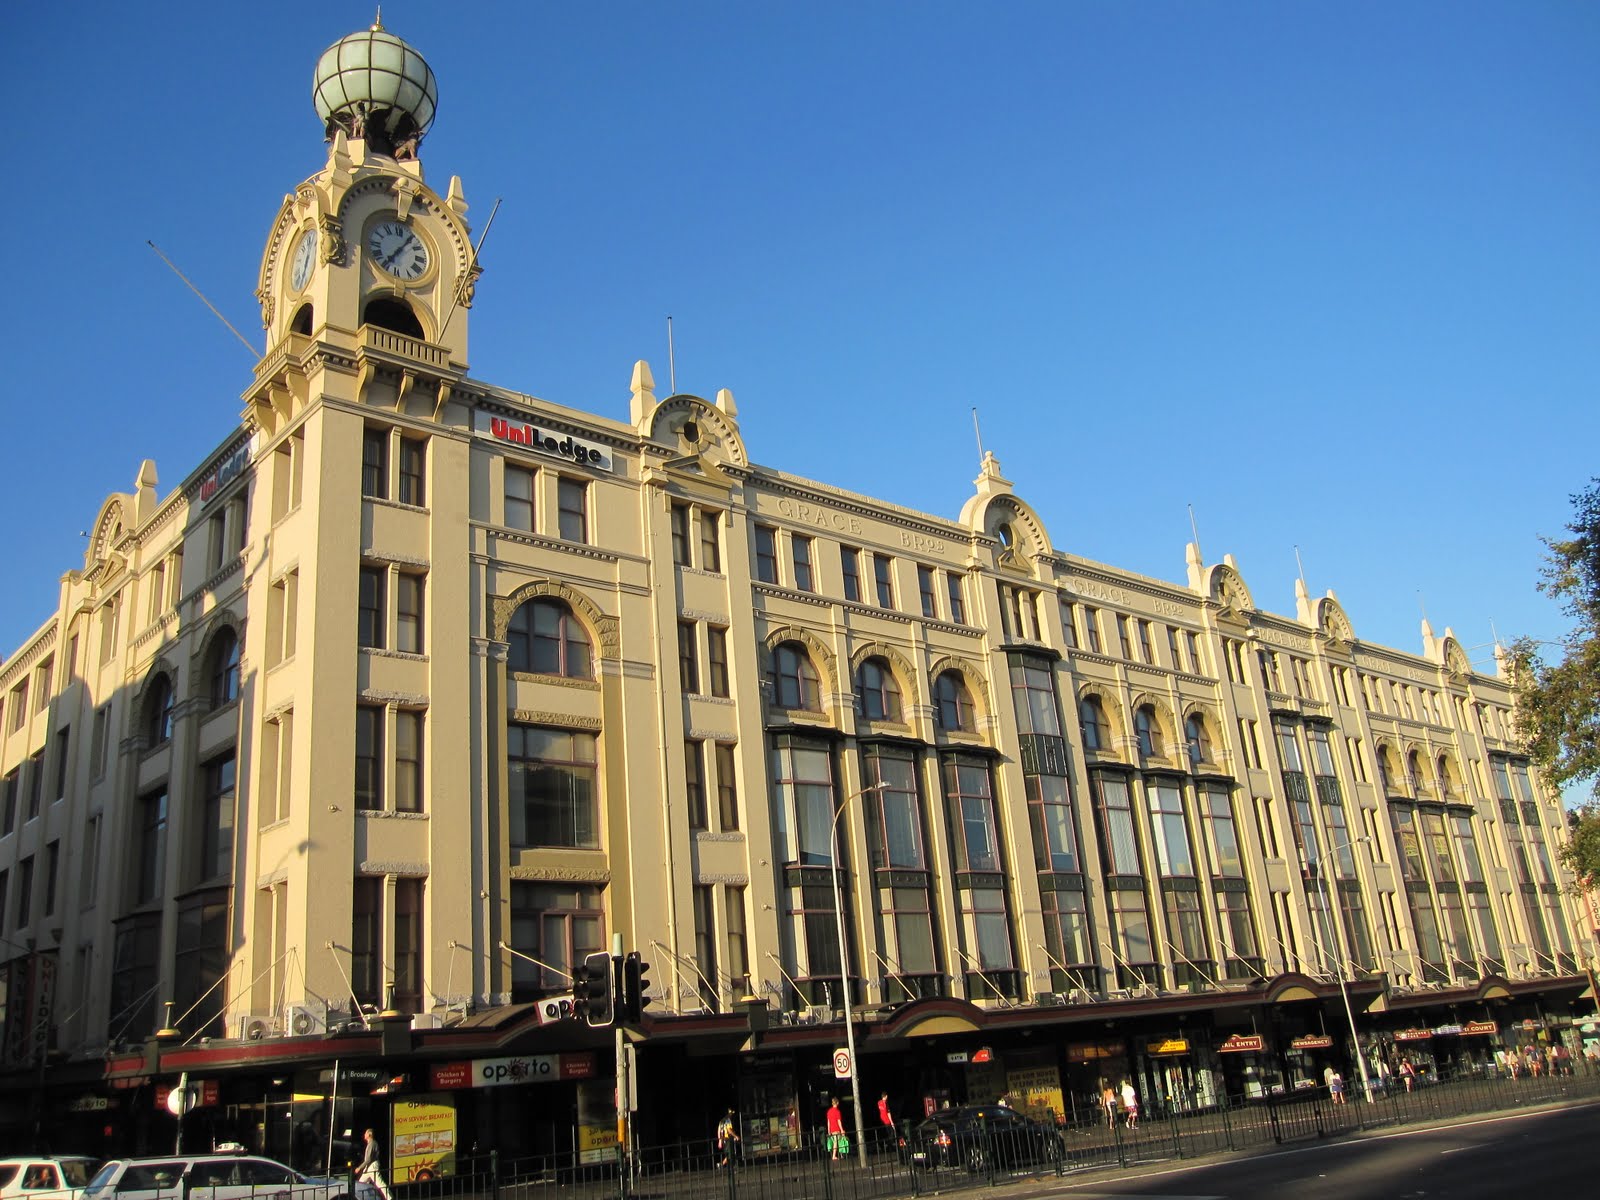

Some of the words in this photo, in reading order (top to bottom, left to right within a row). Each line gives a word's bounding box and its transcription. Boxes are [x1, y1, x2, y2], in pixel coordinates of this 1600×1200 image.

[490, 417, 602, 464] UniLodge
[776, 499, 863, 536] GRACE
[1072, 578, 1131, 606] GRACE
[1256, 626, 1286, 645] RACE
[1292, 1039, 1329, 1047] NEWSAGENCY
[836, 1057, 848, 1069] 50
[350, 1070, 378, 1080] Broadway
[436, 1071, 460, 1079] Chicken
[482, 1058, 551, 1083] oporto
[440, 1078, 462, 1086] Burgers
[1013, 1080, 1033, 1088] YUM
[1037, 1076, 1056, 1086] CHA
[408, 1115, 428, 1123] SERVING
